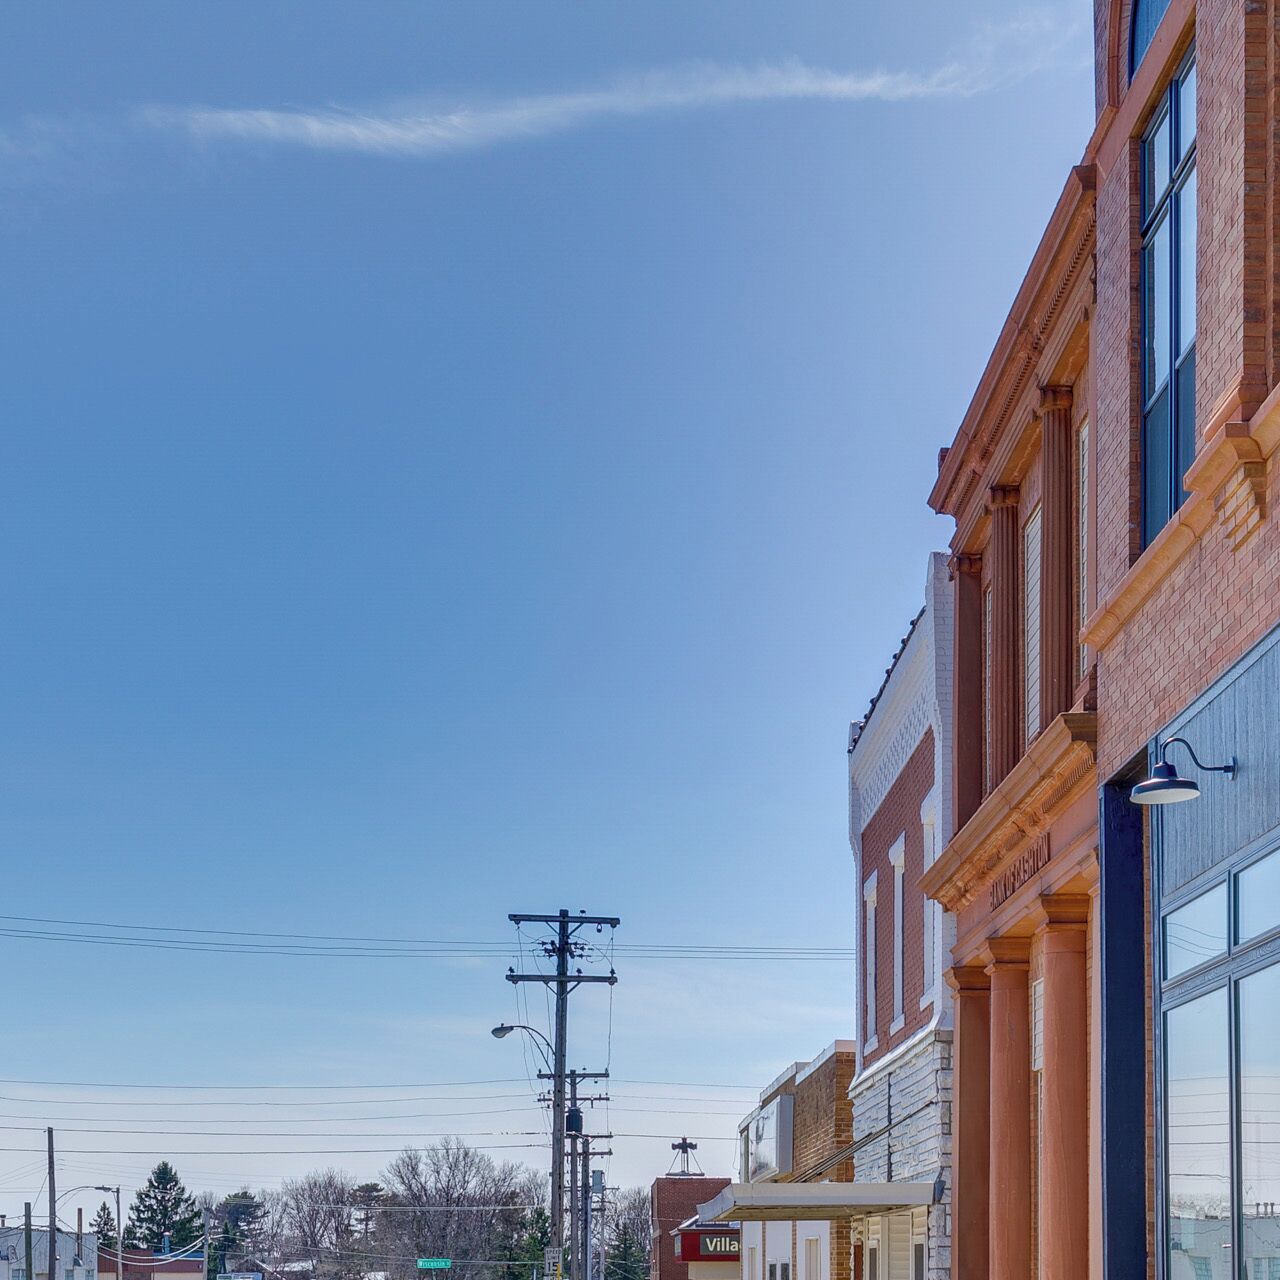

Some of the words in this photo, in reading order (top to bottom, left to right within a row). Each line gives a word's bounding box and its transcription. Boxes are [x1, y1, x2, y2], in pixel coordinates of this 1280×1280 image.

[1016, 832, 1051, 890] CASHTON
[705, 1237, 740, 1252] Villa
[547, 1261, 559, 1272] 15
